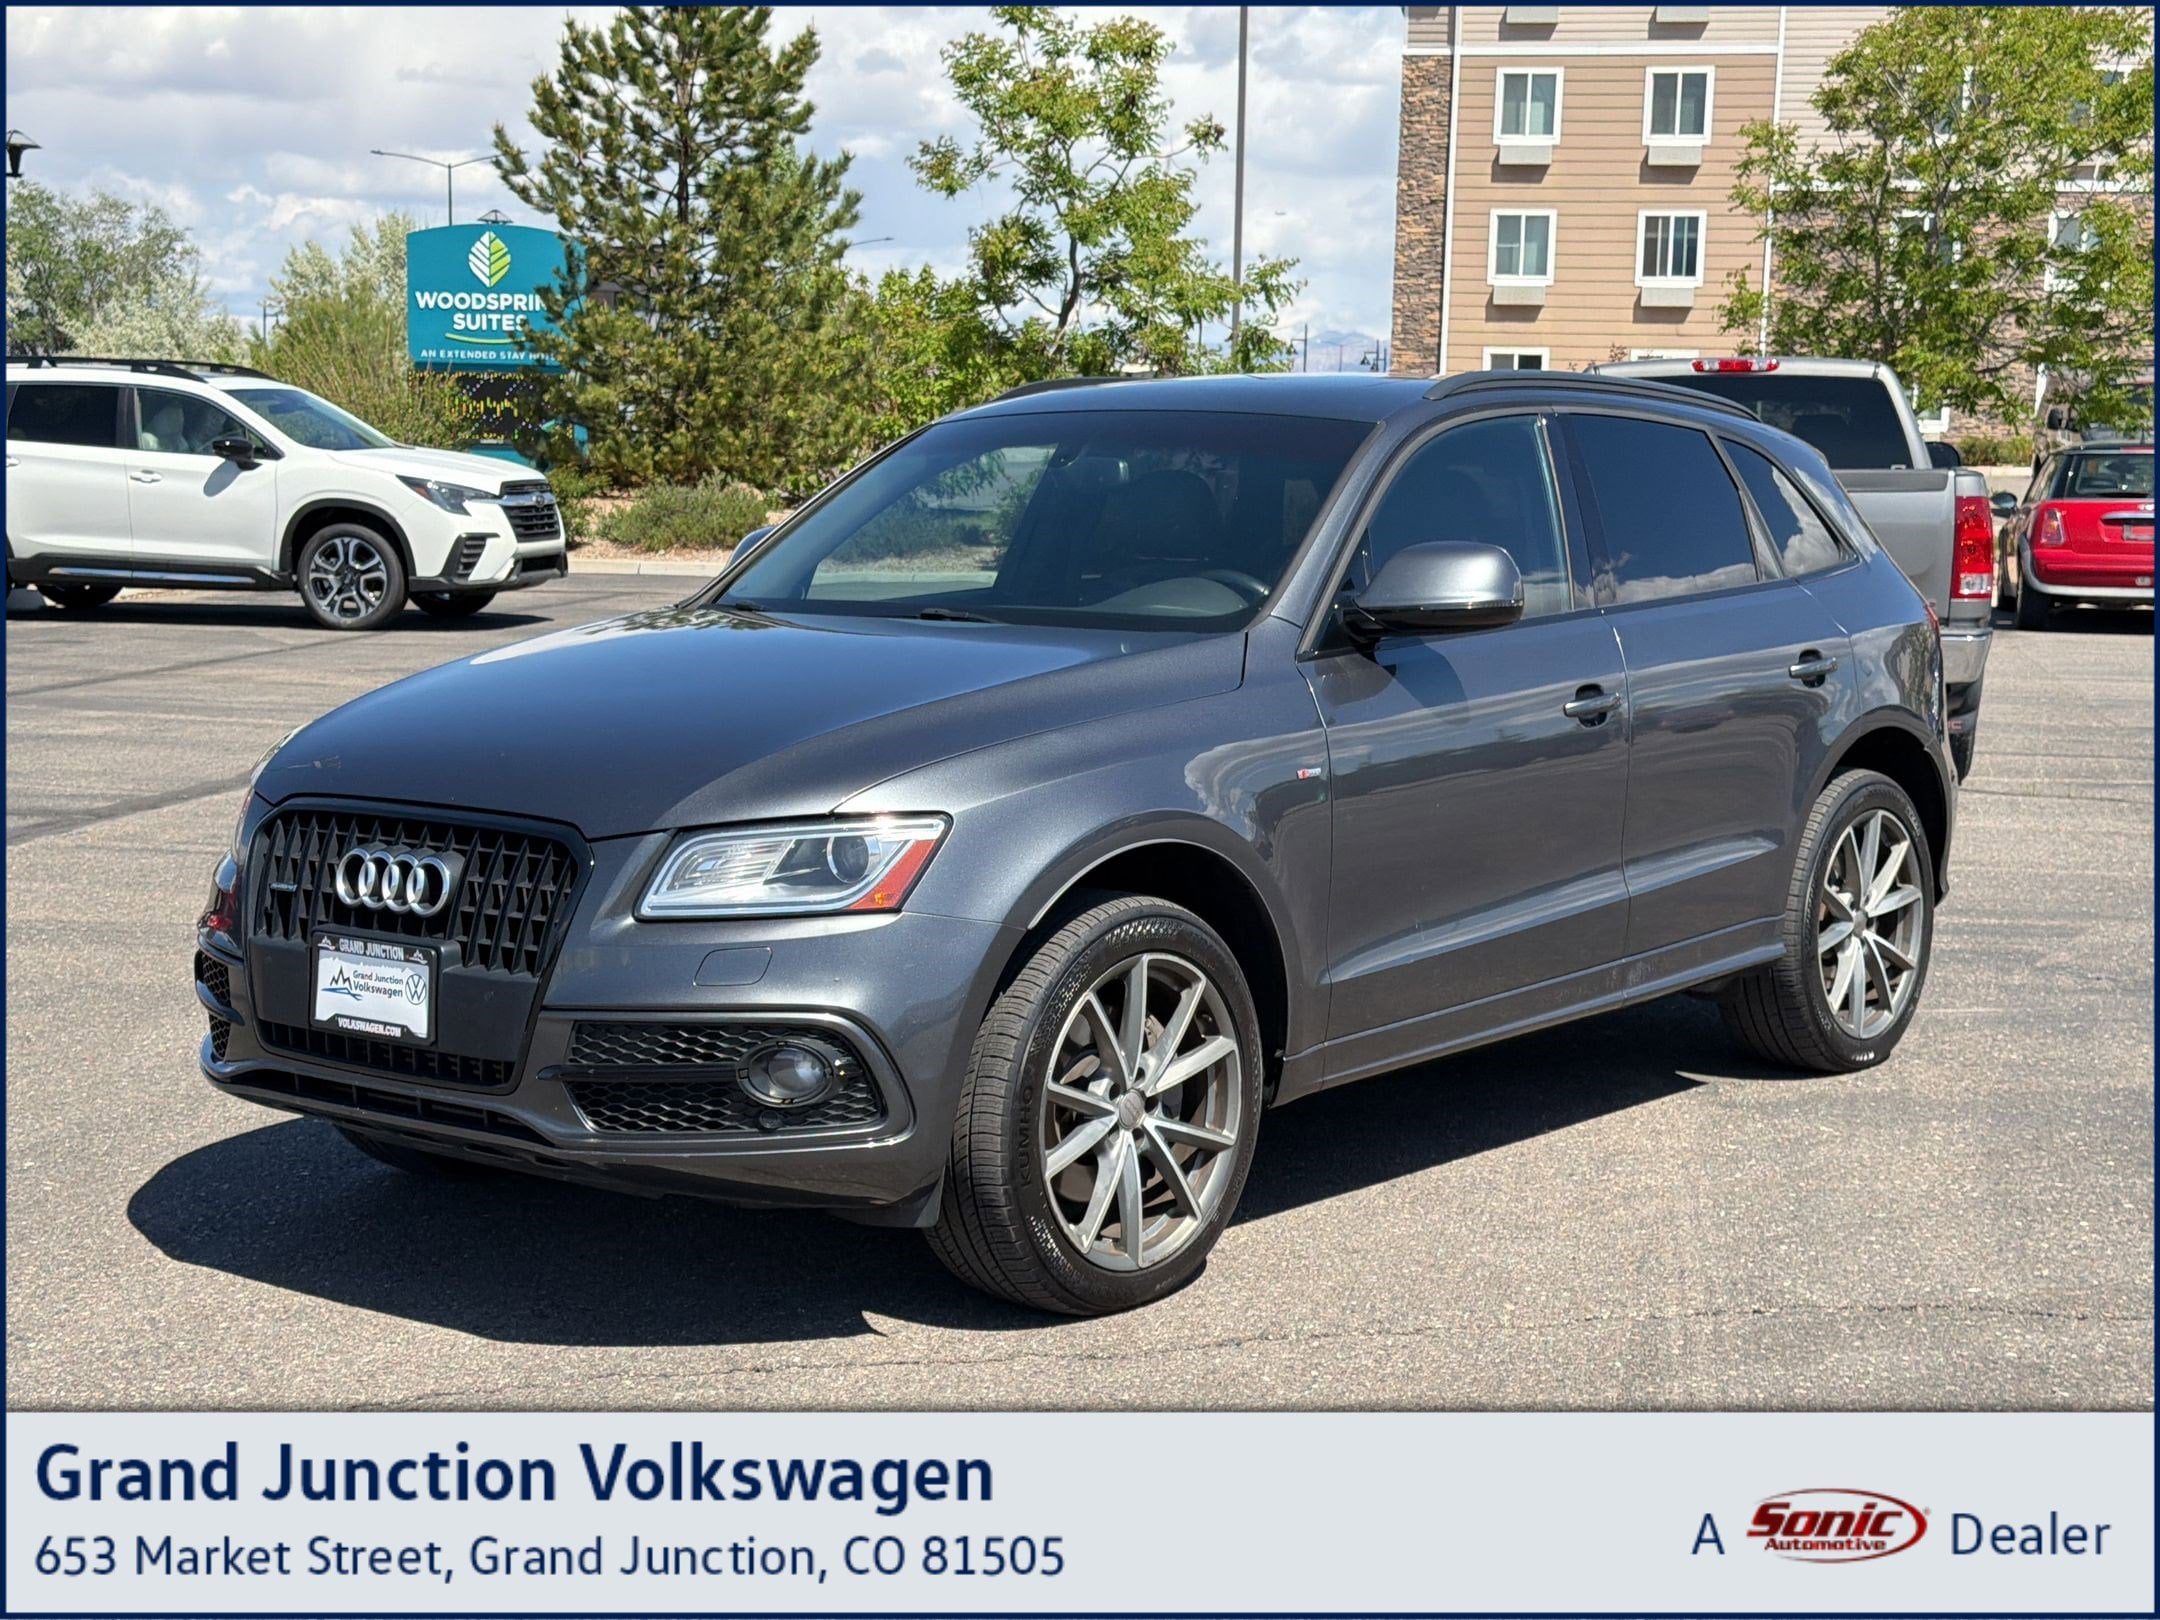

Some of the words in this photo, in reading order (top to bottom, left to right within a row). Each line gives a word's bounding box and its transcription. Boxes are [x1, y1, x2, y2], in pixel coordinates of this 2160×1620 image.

[415, 291, 549, 312] WOODSPRIN
[420, 349, 436, 358] AN
[440, 350, 496, 360] EXTENDED
[500, 351, 525, 361] STAY
[339, 938, 364, 955] GRAND
[365, 943, 405, 961] JUNCTION
[352, 970, 373, 981] Grand
[374, 975, 404, 985] Junction
[353, 980, 403, 998] Volkswagen
[338, 1017, 401, 1037] VOLKSWAGEN.COM
